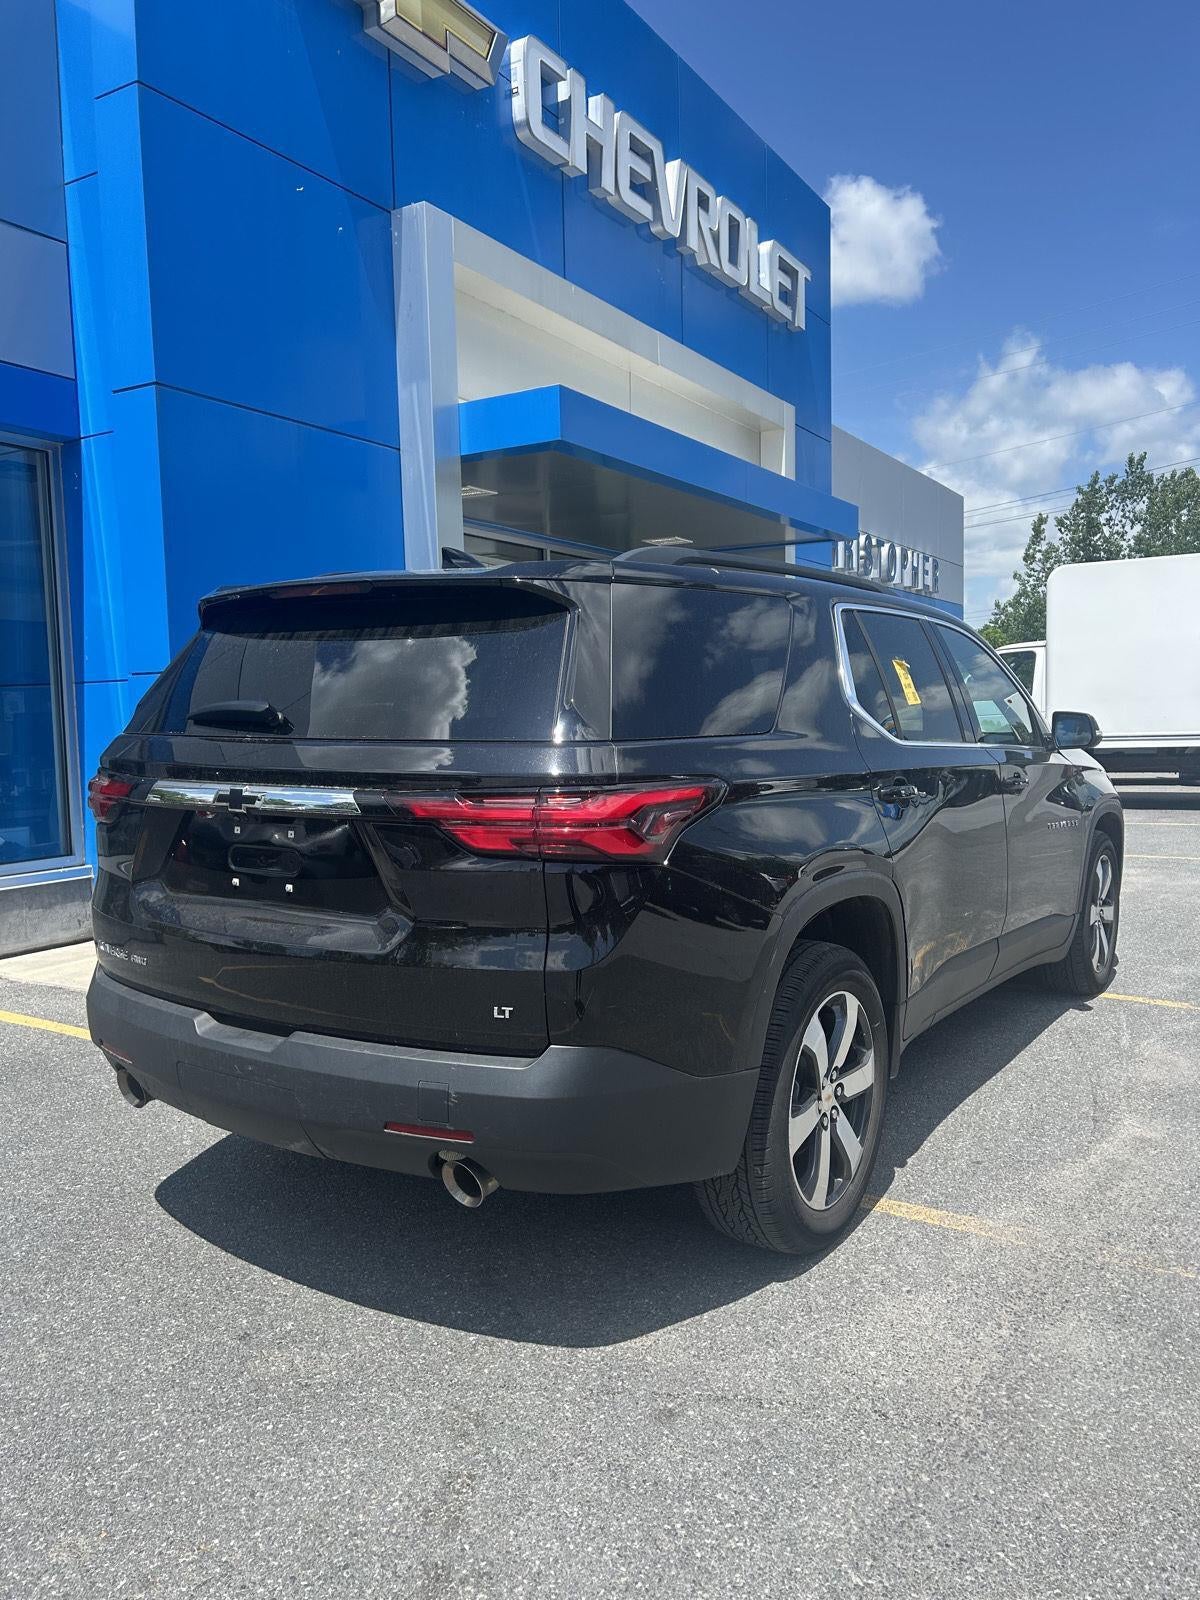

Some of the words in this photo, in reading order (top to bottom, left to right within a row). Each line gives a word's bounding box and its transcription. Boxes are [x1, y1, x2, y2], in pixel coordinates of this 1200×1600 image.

[510, 35, 811, 332] CHEVROLET
[832, 533, 940, 594] RISTOPHER
[493, 1006, 514, 1019] LT
